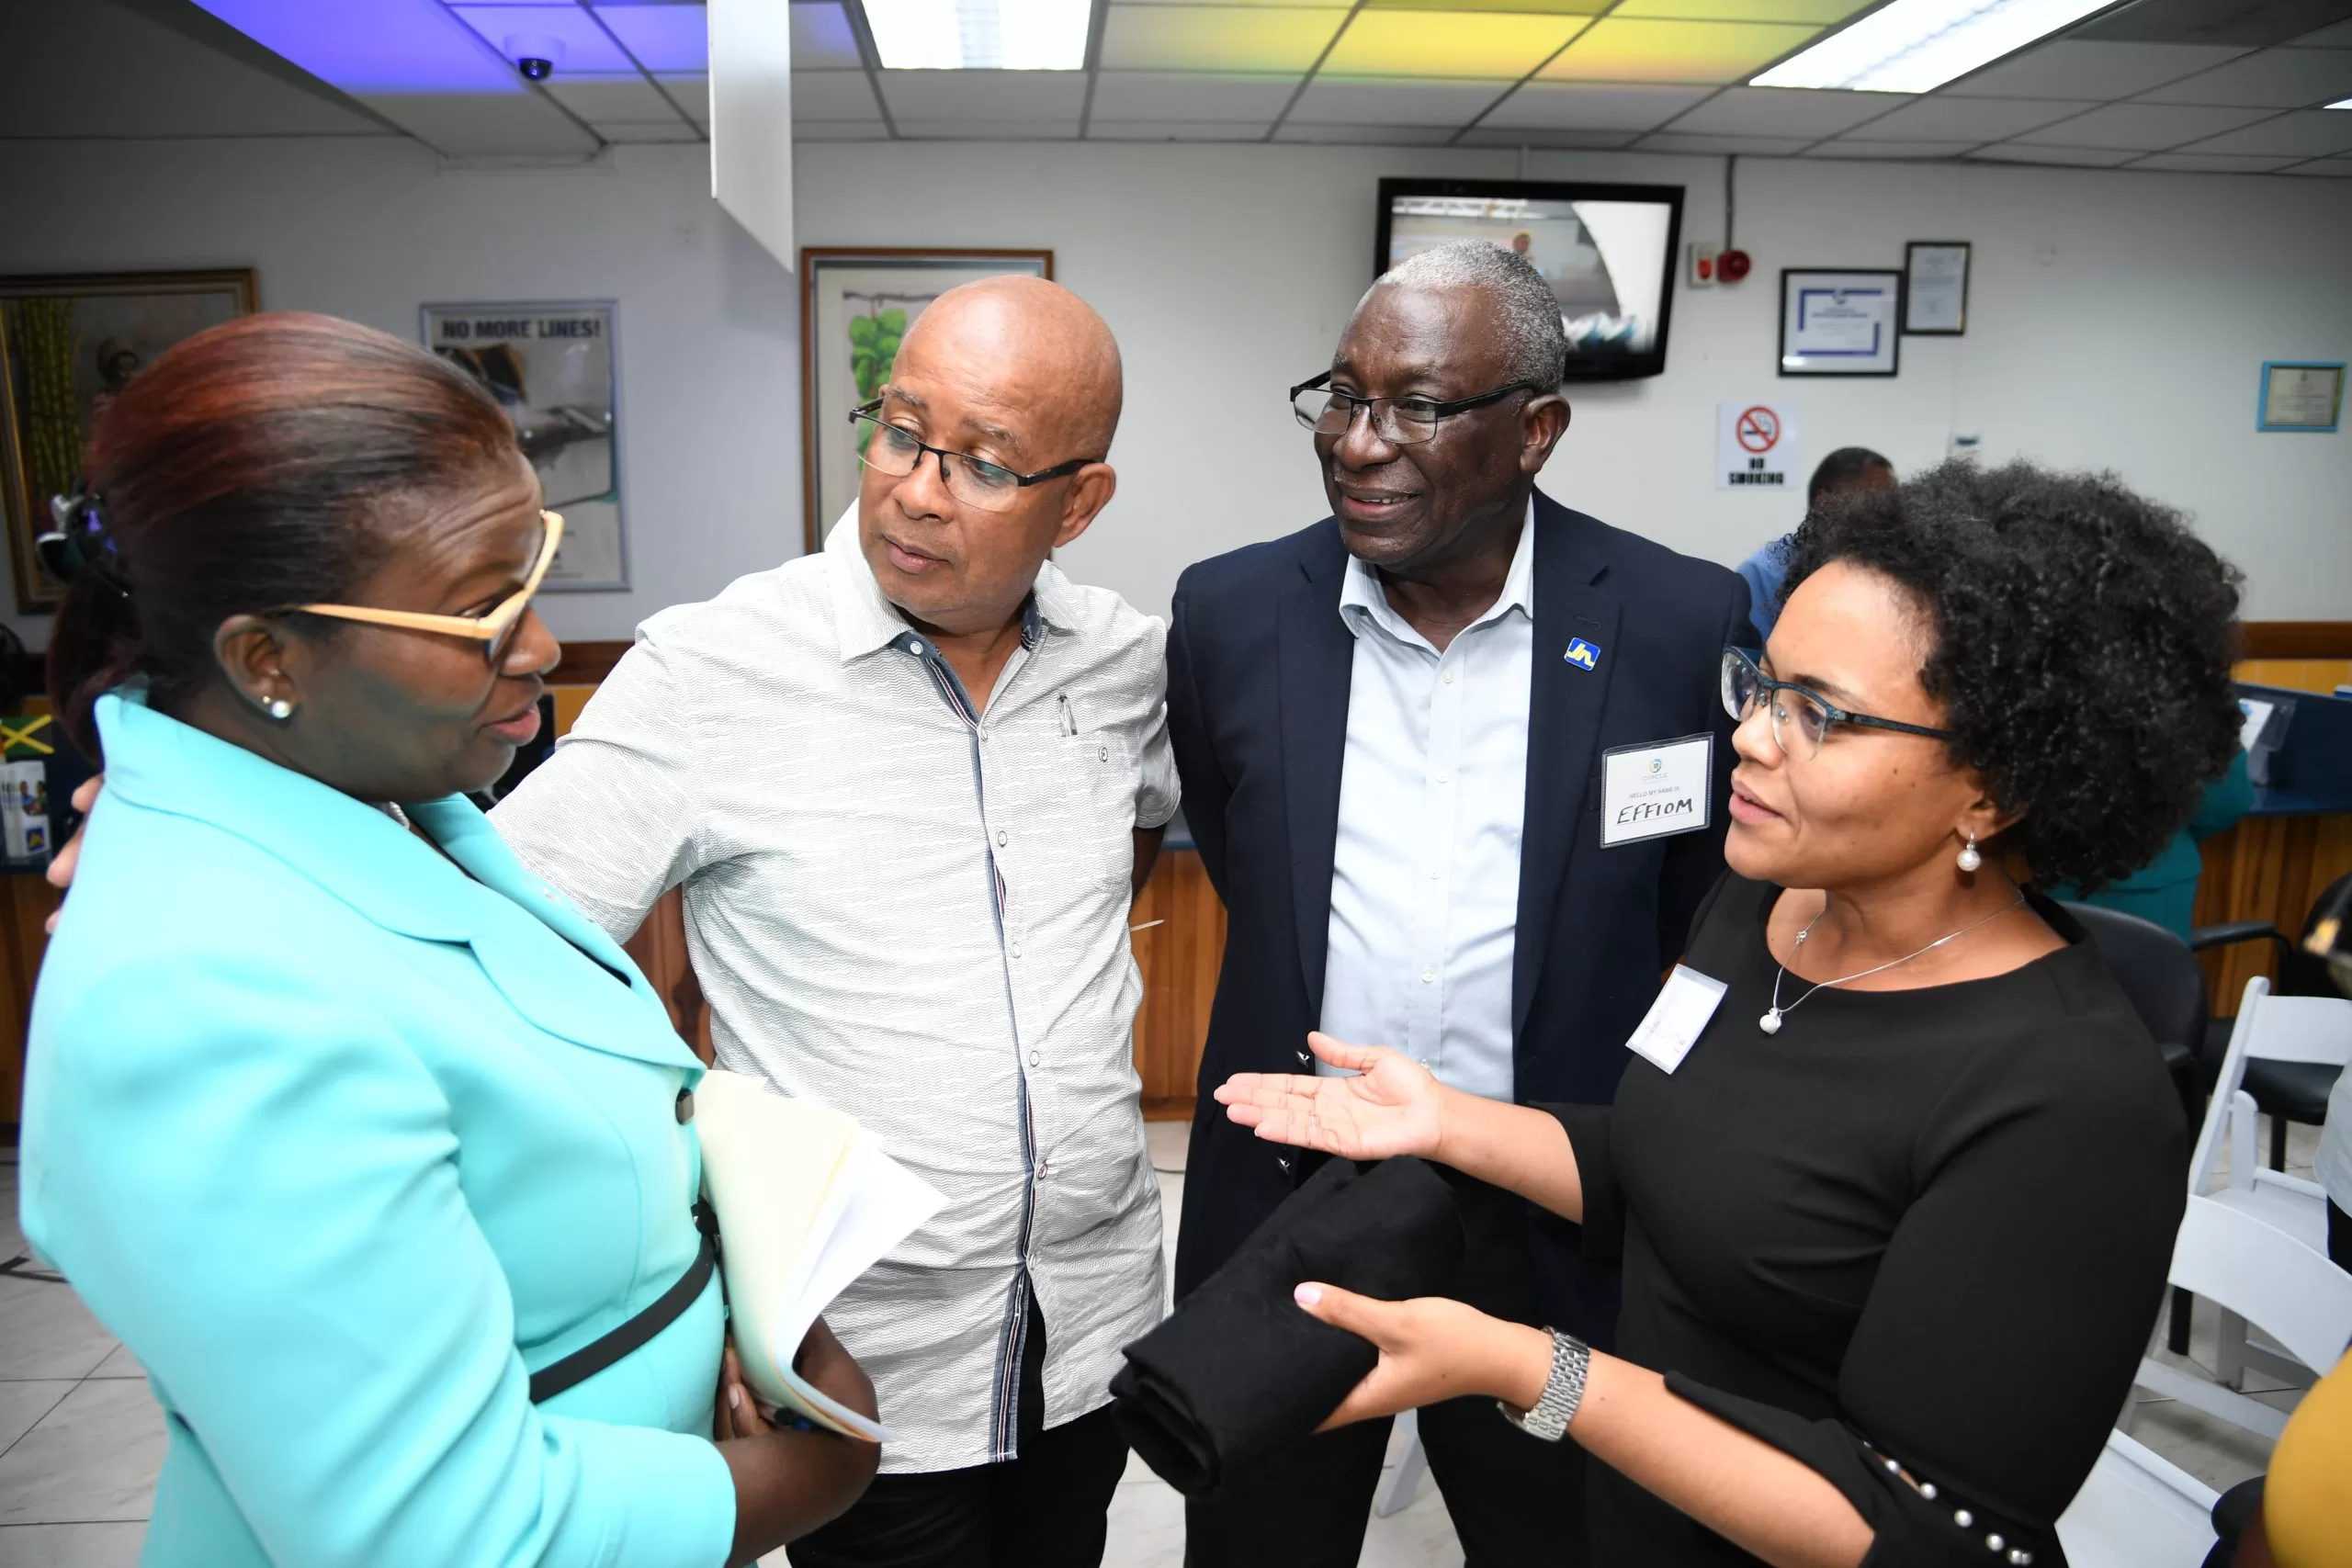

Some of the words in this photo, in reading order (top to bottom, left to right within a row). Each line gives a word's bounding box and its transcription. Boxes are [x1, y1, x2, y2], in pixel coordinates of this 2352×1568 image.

[442, 320, 469, 338] NO
[475, 320, 530, 338] MORE
[537, 319, 601, 339] LINES!
[1748, 457, 1765, 469] NO
[1728, 471, 1784, 485] SMOKING
[1642, 773, 1668, 782] CIRCLE
[1629, 791, 1648, 799] HELLO
[1657, 786, 1673, 795] NAME
[1617, 797, 1693, 825] EFFIOM
